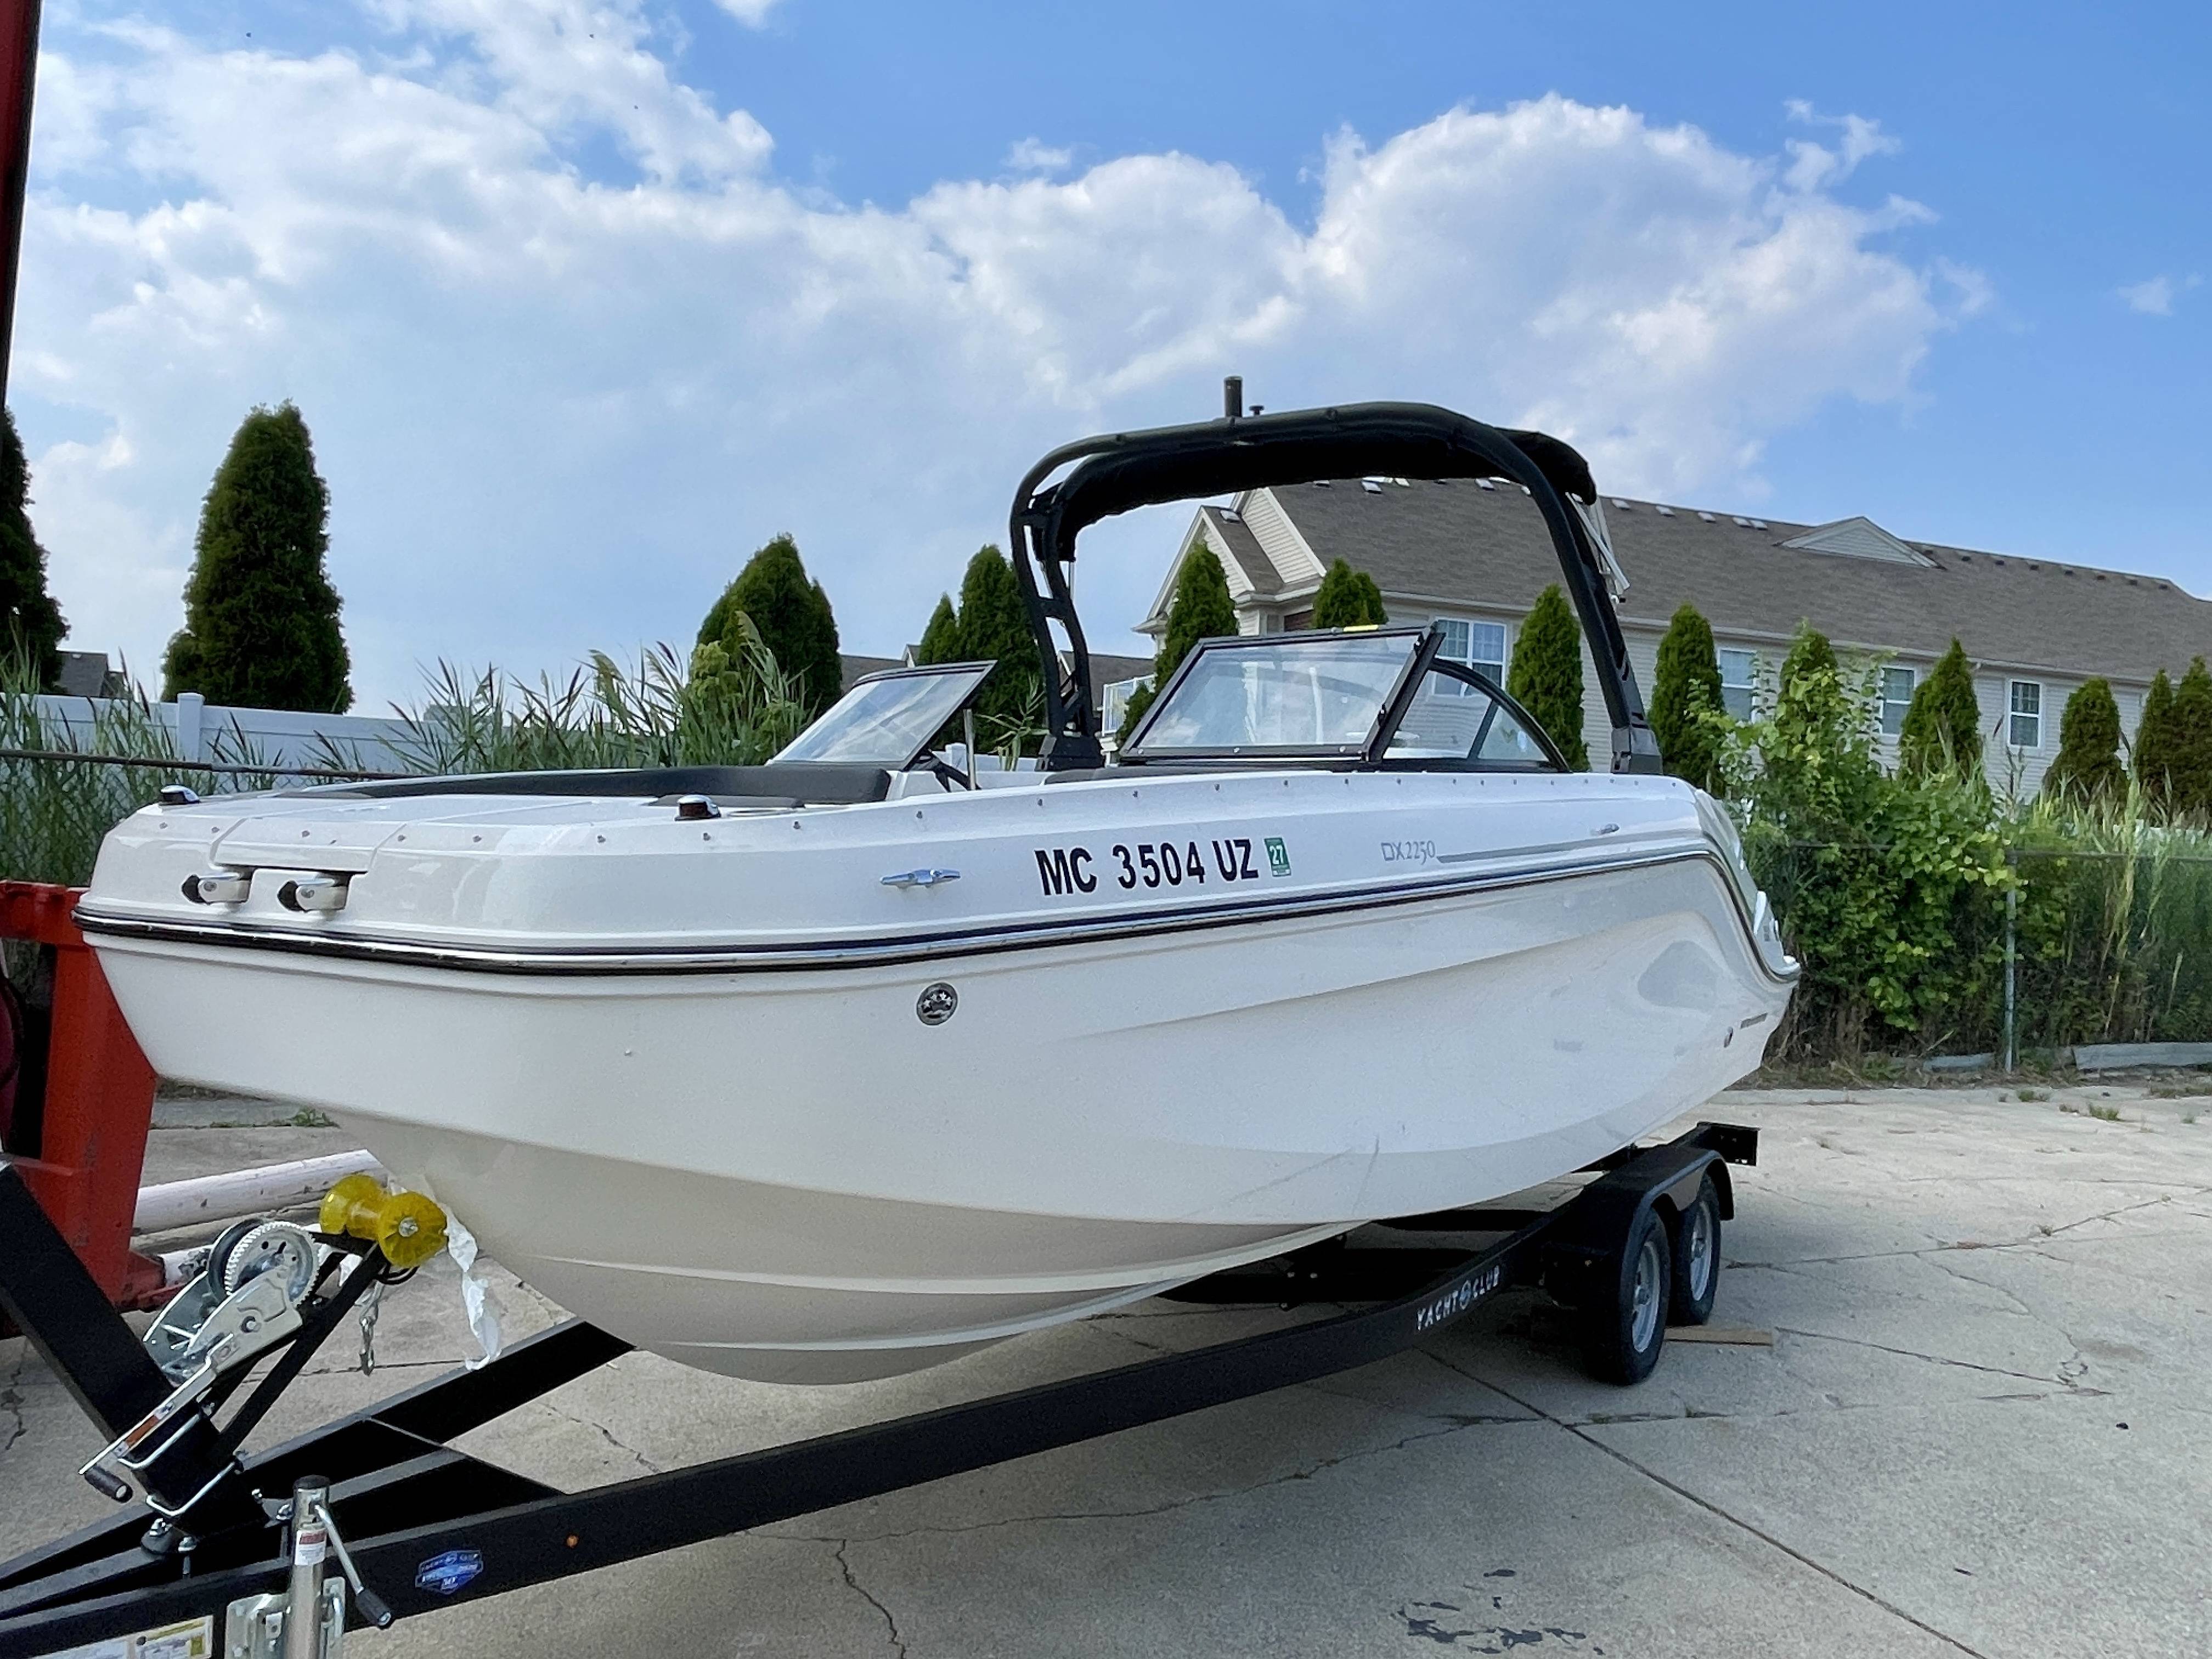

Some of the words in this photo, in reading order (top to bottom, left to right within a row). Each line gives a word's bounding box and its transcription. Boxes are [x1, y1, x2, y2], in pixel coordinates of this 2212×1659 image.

[1269, 845, 1284, 865] 27
[1381, 840, 1435, 865] DX2250
[1035, 848, 1097, 895] MC
[1112, 842, 1205, 889] 3504
[1211, 839, 1259, 882] UZ
